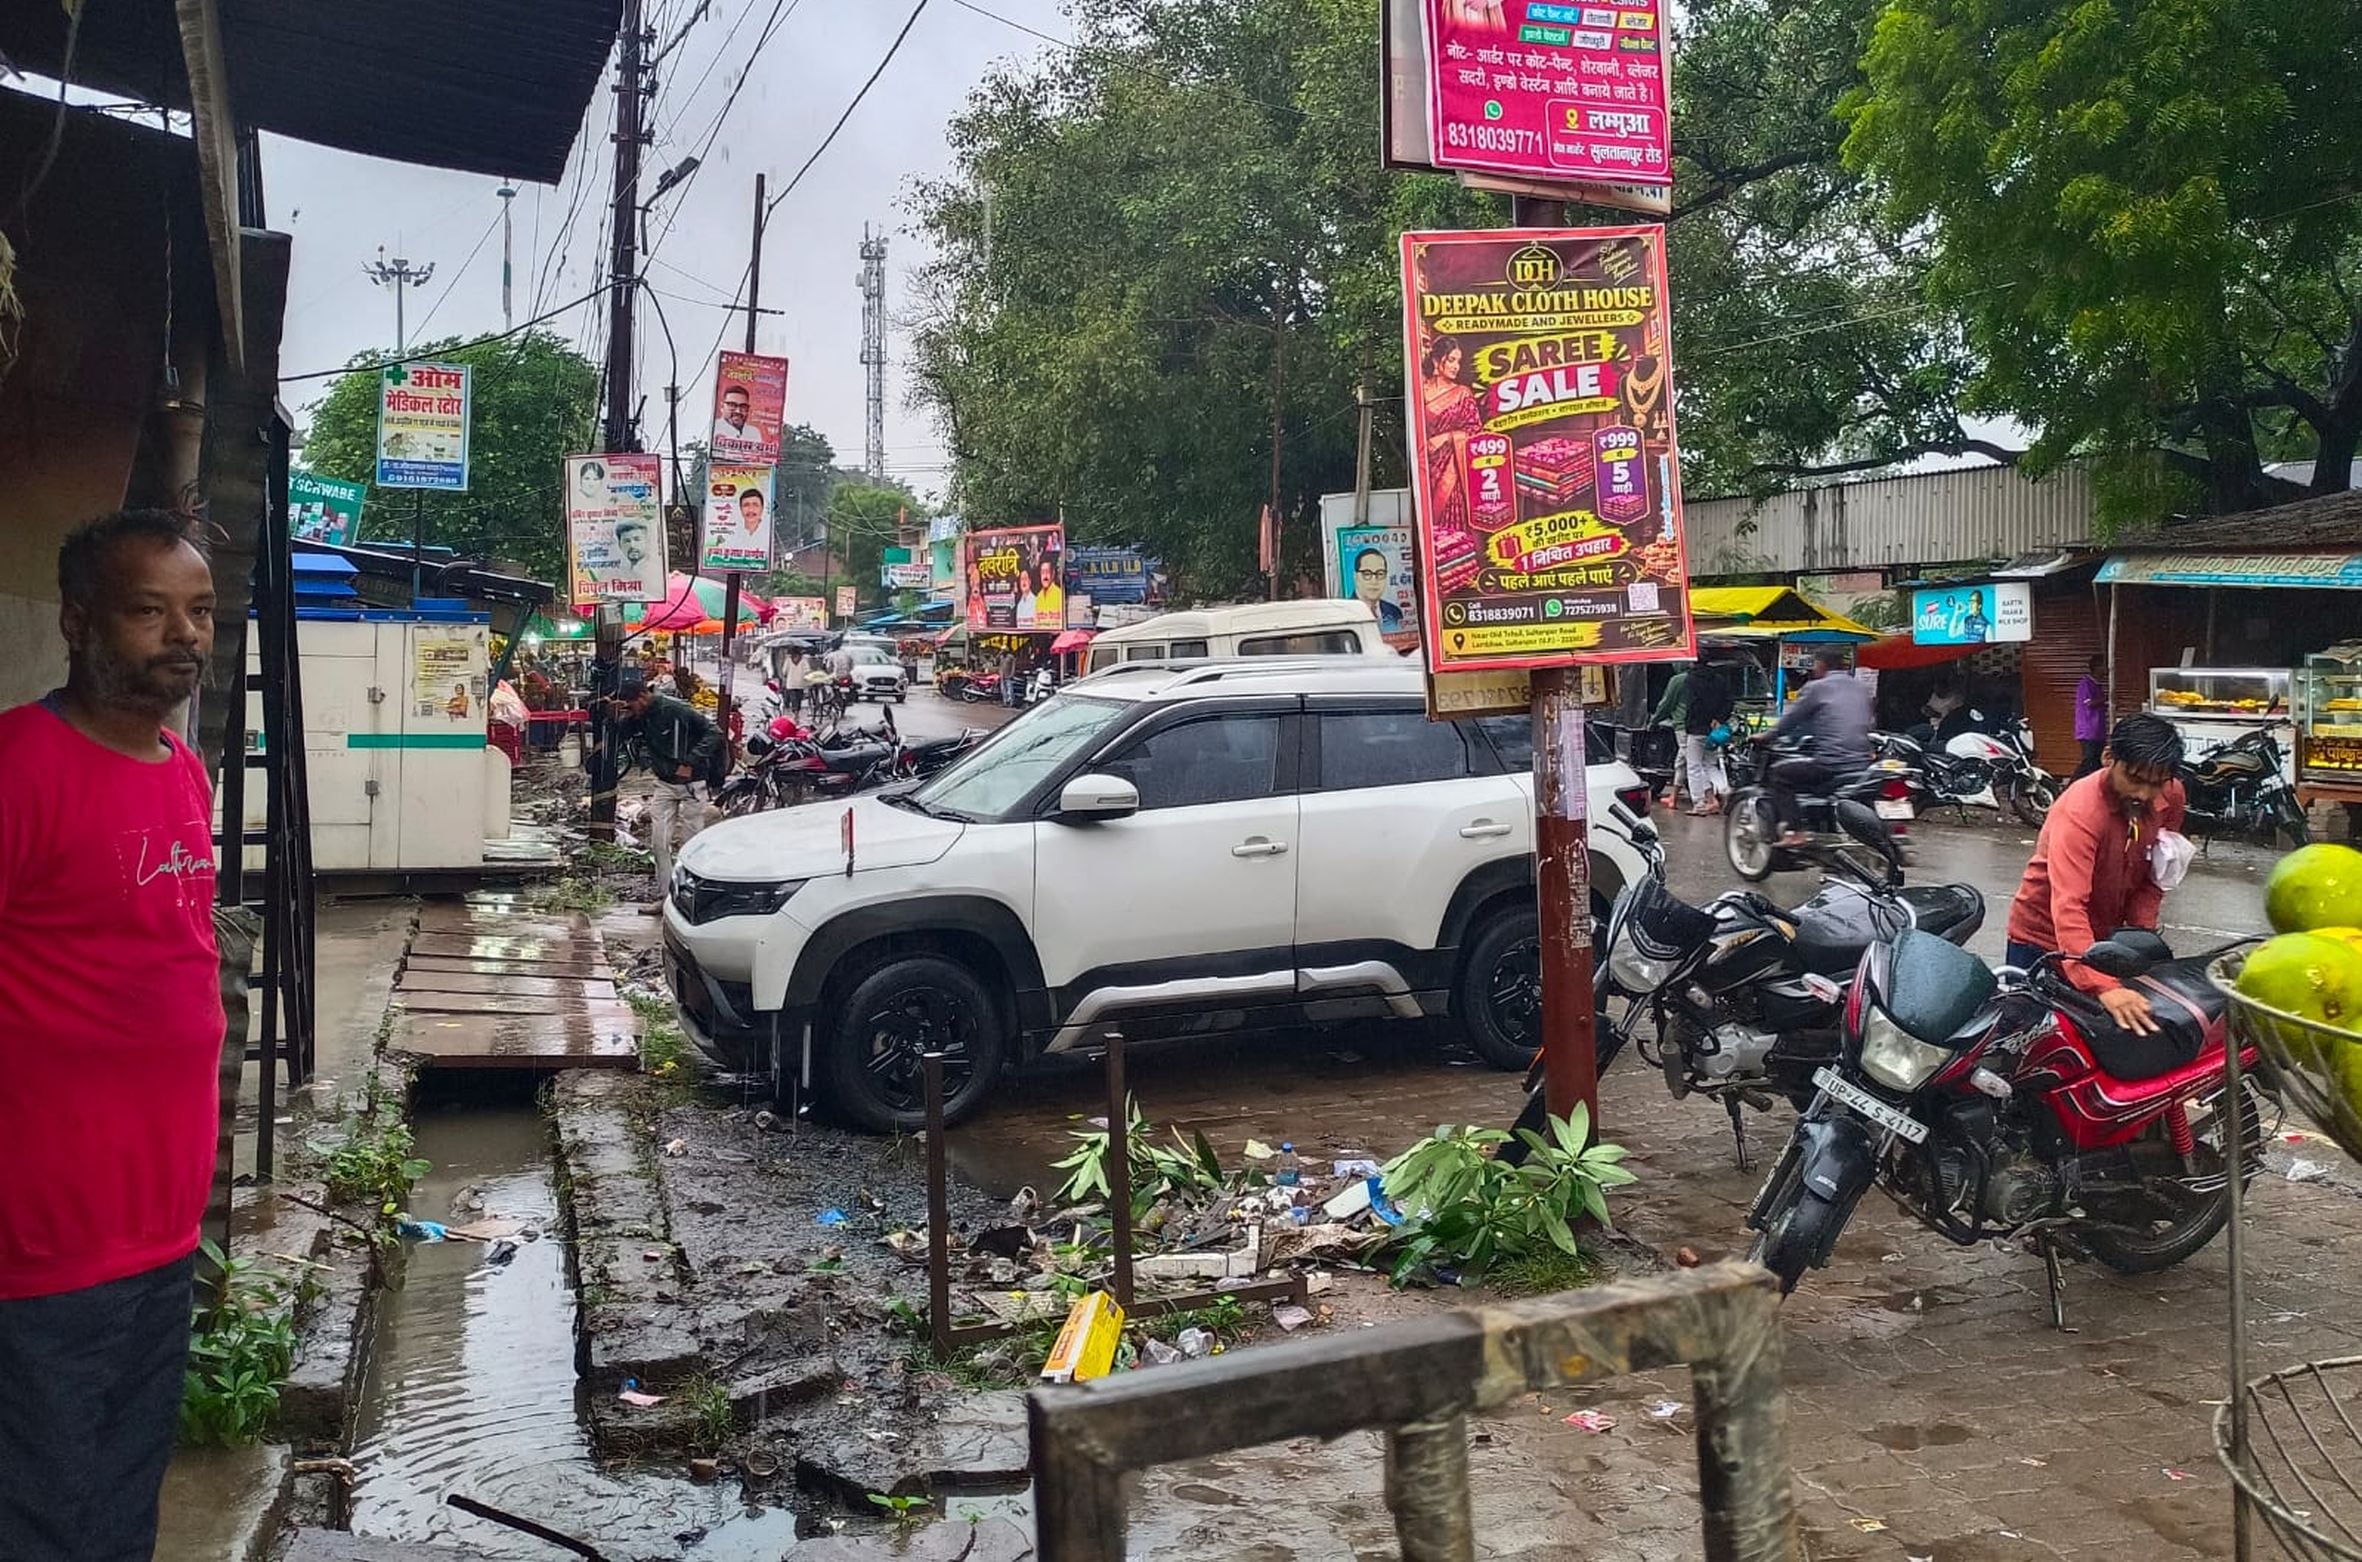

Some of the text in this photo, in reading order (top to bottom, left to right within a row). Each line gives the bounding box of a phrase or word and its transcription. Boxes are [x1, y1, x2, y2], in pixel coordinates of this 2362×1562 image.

[1476, 44, 1504, 65] आर्डर
[1506, 52, 1523, 67] पर
[1626, 58, 1660, 79] ब्लेजर
[1553, 76, 1579, 96] आदि
[1580, 78, 1611, 99] बनाये
[1612, 82, 1637, 100] जाते
[1448, 121, 1544, 156] 8318039771
[1644, 144, 1663, 164] रोड
[1423, 286, 1653, 318] DEEPAK CLOTH HOUSE
[1455, 312, 1626, 330] READYMADE AND JEWELLERS
[1488, 333, 1605, 377] SAREE
[411, 366, 464, 389] ओम
[1497, 365, 1602, 413] SALE
[386, 389, 435, 414] मेडिकल
[1469, 438, 1507, 456] ₹499
[1598, 431, 1638, 449] ₹999
[1480, 468, 1499, 491] 2
[1612, 460, 1630, 483] 5
[296, 478, 356, 501] SCHWABE
[1525, 515, 1588, 539] ₹5,000+
[1532, 537, 1545, 548] की
[1572, 530, 1584, 539] पर
[1521, 537, 1612, 571] 1 निश्चित उपहार
[1499, 564, 1615, 590] पहले आएं पहले पाएं
[578, 580, 609, 598] विपुल
[1468, 606, 1535, 623] 8318839071
[1918, 613, 1949, 631] SURE
[1828, 1079, 1847, 1096] UP
[1871, 1106, 1883, 1120] S
